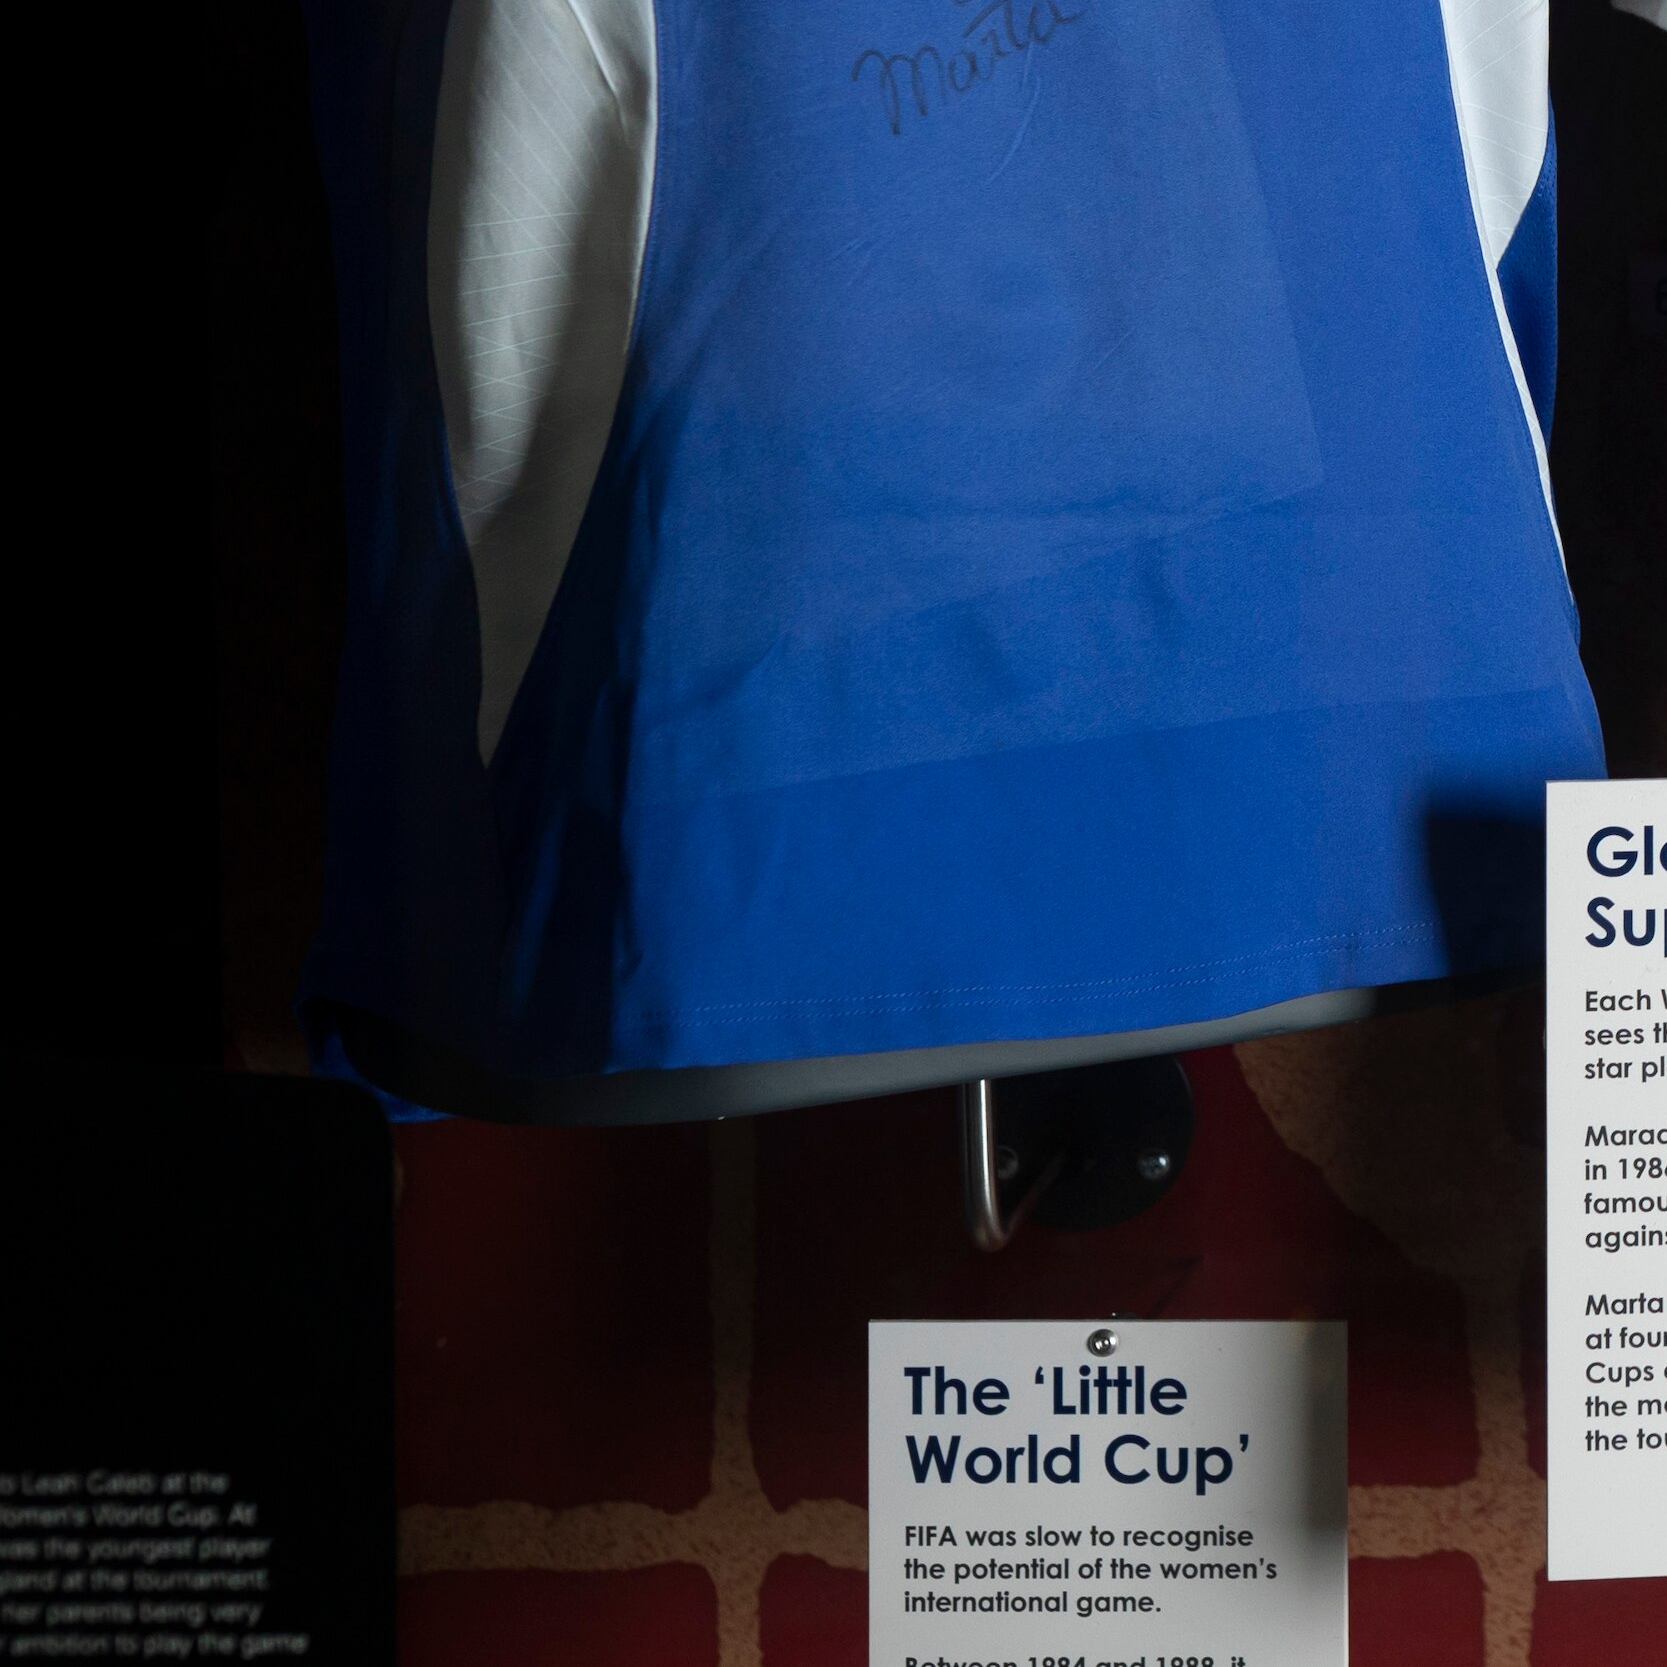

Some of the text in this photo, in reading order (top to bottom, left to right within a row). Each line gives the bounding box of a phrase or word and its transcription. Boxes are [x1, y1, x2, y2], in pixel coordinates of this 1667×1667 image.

[1585, 989, 1651, 1012] Each
[1584, 1028, 1645, 1046] sees
[1584, 1057, 1633, 1080] star
[1584, 1158, 1607, 1181] in
[1585, 1292, 1664, 1316] Marta
[1585, 1327, 1613, 1350] at
[1585, 1361, 1654, 1388] Cups
[903, 1364, 1188, 1416] The ‘Little
[1585, 1395, 1628, 1418] the
[1585, 1429, 1628, 1452] the
[905, 1433, 1250, 1496] World Cup’
[190, 1472, 230, 1495] the
[92, 1503, 165, 1527] World
[905, 1524, 1254, 1552] FIFA was slow to recognise
[44, 1538, 83, 1559] the
[88, 1538, 196, 1564] youngest
[199, 1538, 272, 1563] player
[62, 1570, 86, 1591] at
[90, 1569, 129, 1591] the
[903, 1557, 1278, 1585] the potential of the women’s
[46, 1602, 136, 1627] parents
[139, 1601, 207, 1628] being
[210, 1603, 263, 1627] very
[904, 1590, 1161, 1618] international game.
[115, 1634, 140, 1656] to
[144, 1633, 194, 1660] play
[197, 1633, 237, 1656] the
[241, 1635, 310, 1661] game
